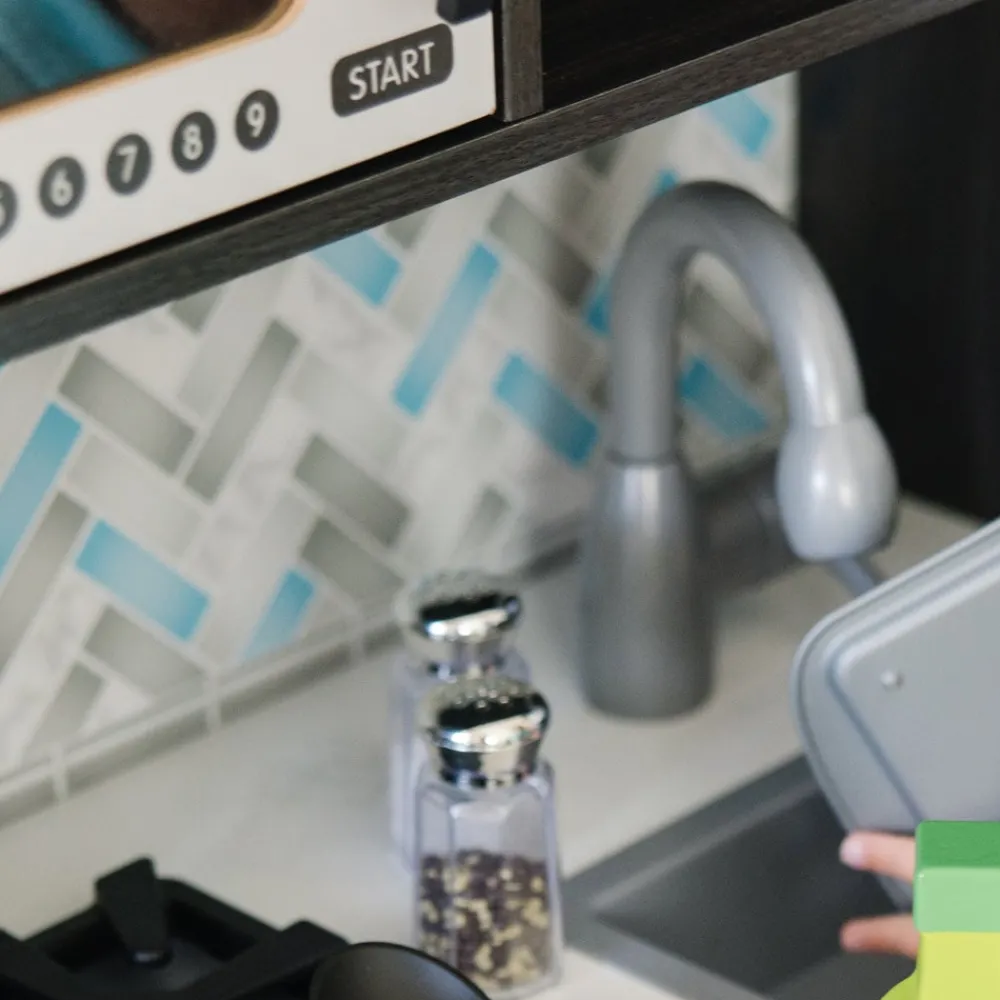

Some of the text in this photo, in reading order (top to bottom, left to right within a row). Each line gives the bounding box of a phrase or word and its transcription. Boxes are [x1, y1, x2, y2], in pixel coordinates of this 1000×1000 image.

[347, 41, 435, 101] START
[50, 102, 267, 208] 6 7 8 9
